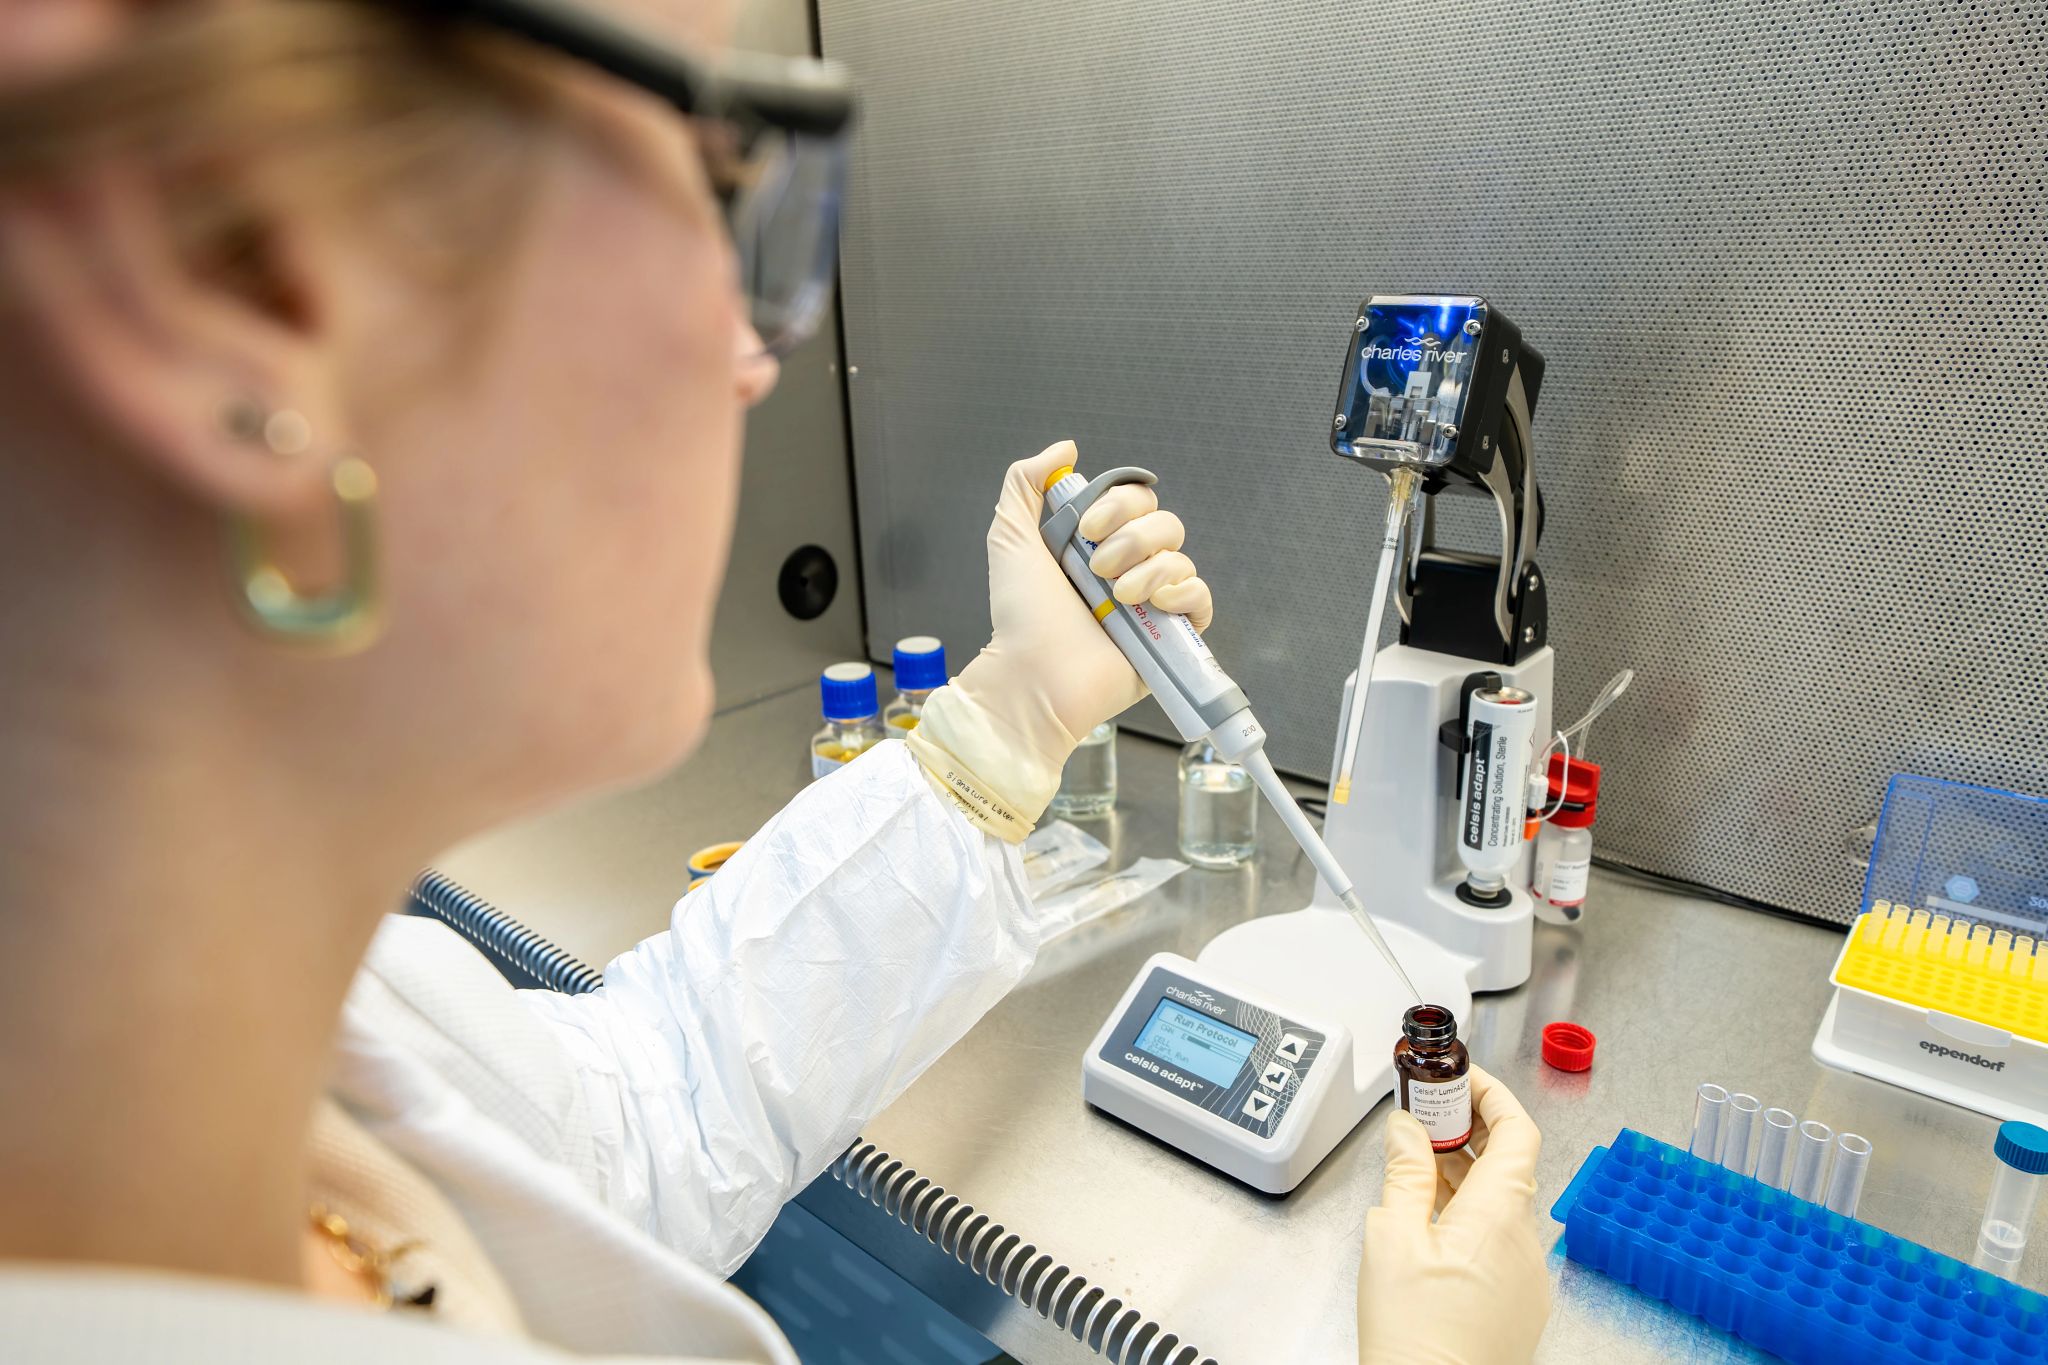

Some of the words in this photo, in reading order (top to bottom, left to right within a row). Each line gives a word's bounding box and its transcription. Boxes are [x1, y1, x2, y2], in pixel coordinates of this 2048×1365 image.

[1361, 345, 1422, 362] charles
[1425, 347, 1467, 364] river
[1143, 620, 1161, 640] plus
[1242, 724, 1257, 738] 200
[1496, 736, 1508, 760] Sterile
[1493, 762, 1505, 794] Solution,
[947, 772, 989, 805] Signature
[991, 803, 1016, 823] Latex
[1469, 802, 1481, 845] celsis
[1488, 793, 1504, 847] Concentrating
[1166, 986, 1202, 1007] charles
[1203, 1001, 1226, 1015] river
[1174, 1015, 1194, 1029] Run
[1197, 1023, 1238, 1047] Protocol
[1125, 1053, 1159, 1074] celsis
[1919, 1039, 2006, 1072] eppendorf
